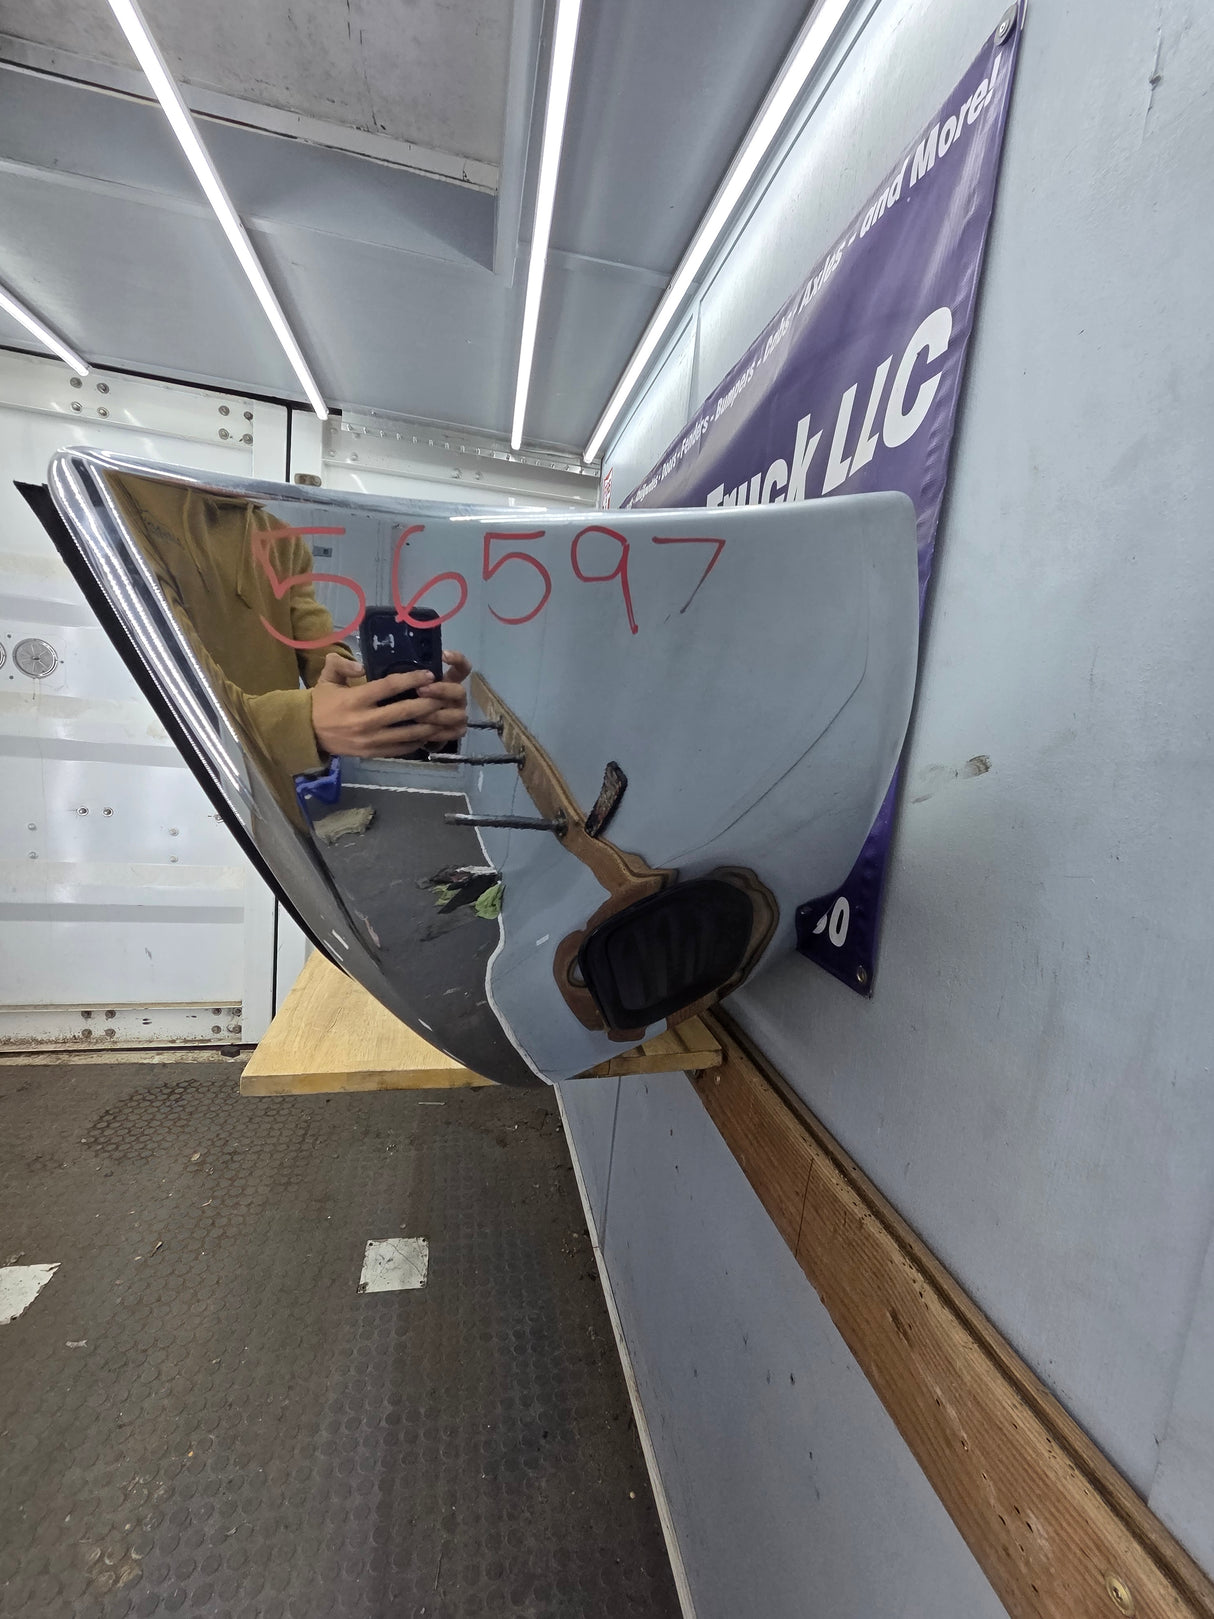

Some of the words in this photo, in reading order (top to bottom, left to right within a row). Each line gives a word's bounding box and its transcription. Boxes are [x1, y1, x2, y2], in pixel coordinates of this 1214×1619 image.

[680, 415, 710, 459] Fenders
[715, 361, 756, 421] Bumpers
[799, 241, 846, 315] Axles
[860, 154, 911, 239] and
[909, 51, 1002, 188] More!
[706, 413, 823, 508] uck
[821, 306, 953, 496] LLC
[251, 525, 726, 649] 56597
